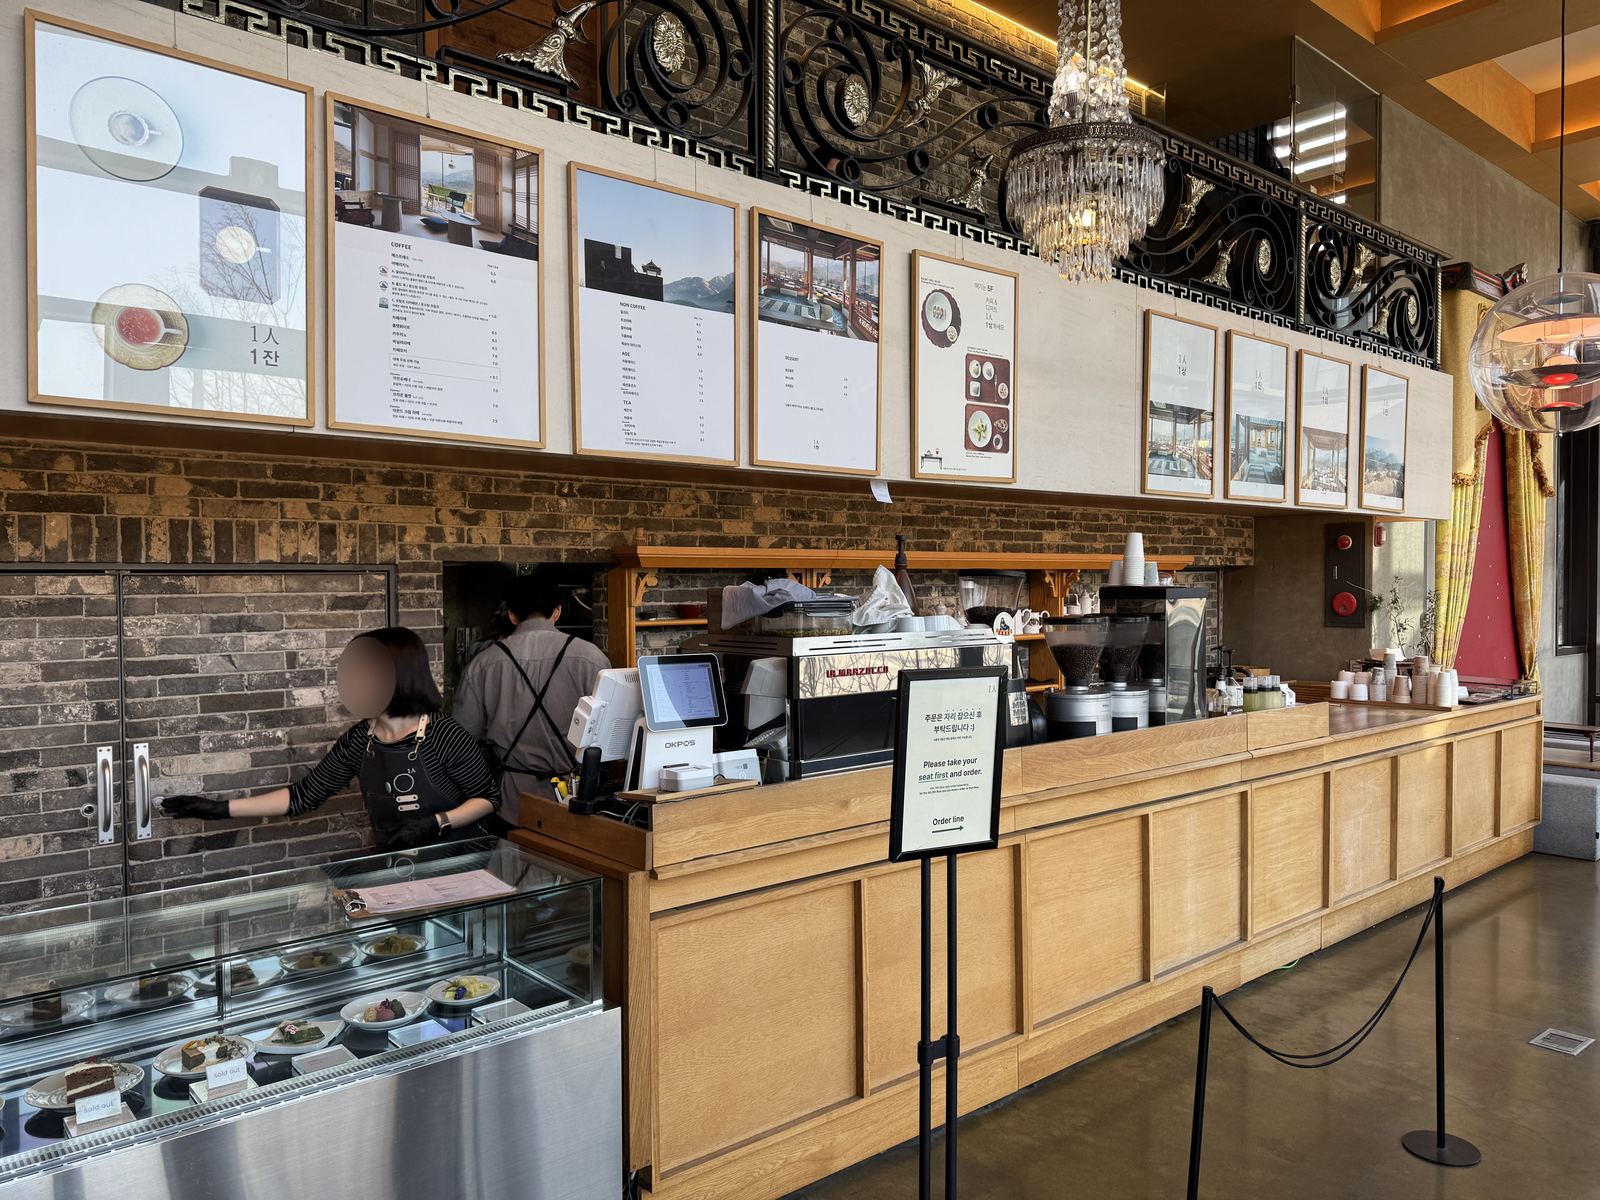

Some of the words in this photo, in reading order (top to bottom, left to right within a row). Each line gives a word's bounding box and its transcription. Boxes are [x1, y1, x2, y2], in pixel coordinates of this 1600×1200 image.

[391, 242, 411, 250] COFFEE
[250, 348, 280, 367] 1잔
[925, 714, 943, 722] 주문은
[944, 712, 956, 721] 자리
[957, 712, 975, 720] 잡으신
[934, 724, 969, 733] 부탁드립니다
[665, 740, 695, 748] OKPOS
[963, 757, 978, 766] your
[214, 1070, 228, 1078] sold
[84, 1104, 100, 1113] sold
